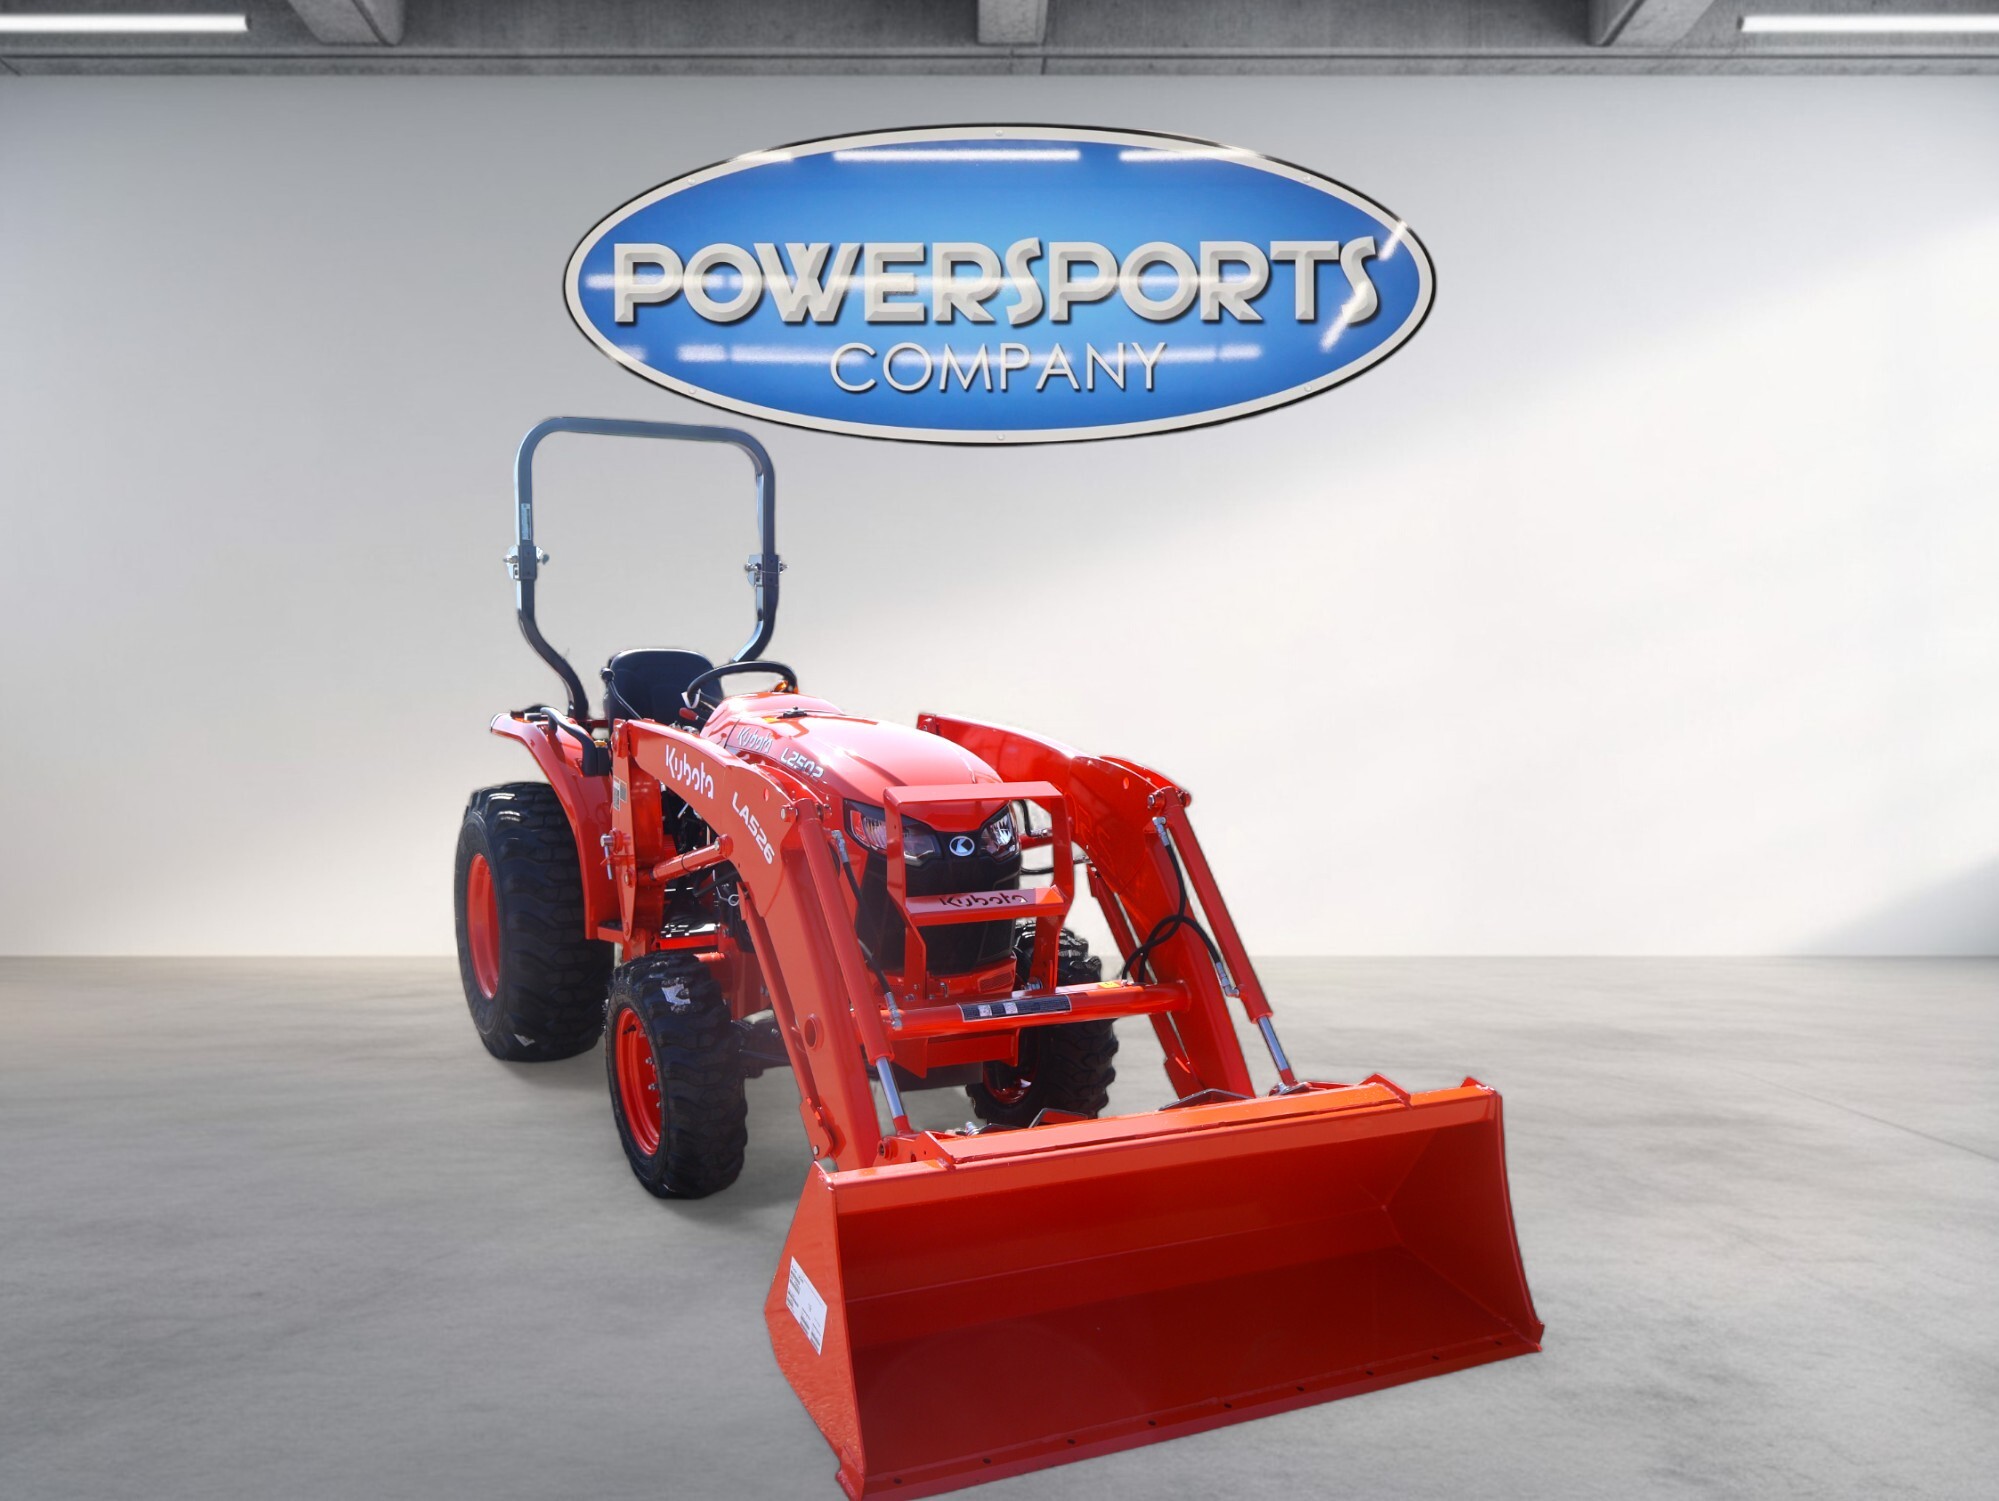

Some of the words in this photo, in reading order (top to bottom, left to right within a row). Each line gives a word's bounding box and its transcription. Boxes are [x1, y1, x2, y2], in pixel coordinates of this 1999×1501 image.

[614, 236, 1378, 325] POWERSPORTS
[830, 342, 1166, 391] COMPANY
[737, 727, 773, 754] Kubota
[665, 744, 714, 800] Kubota
[732, 791, 775, 865] LA526
[939, 892, 1028, 907] Kubota
